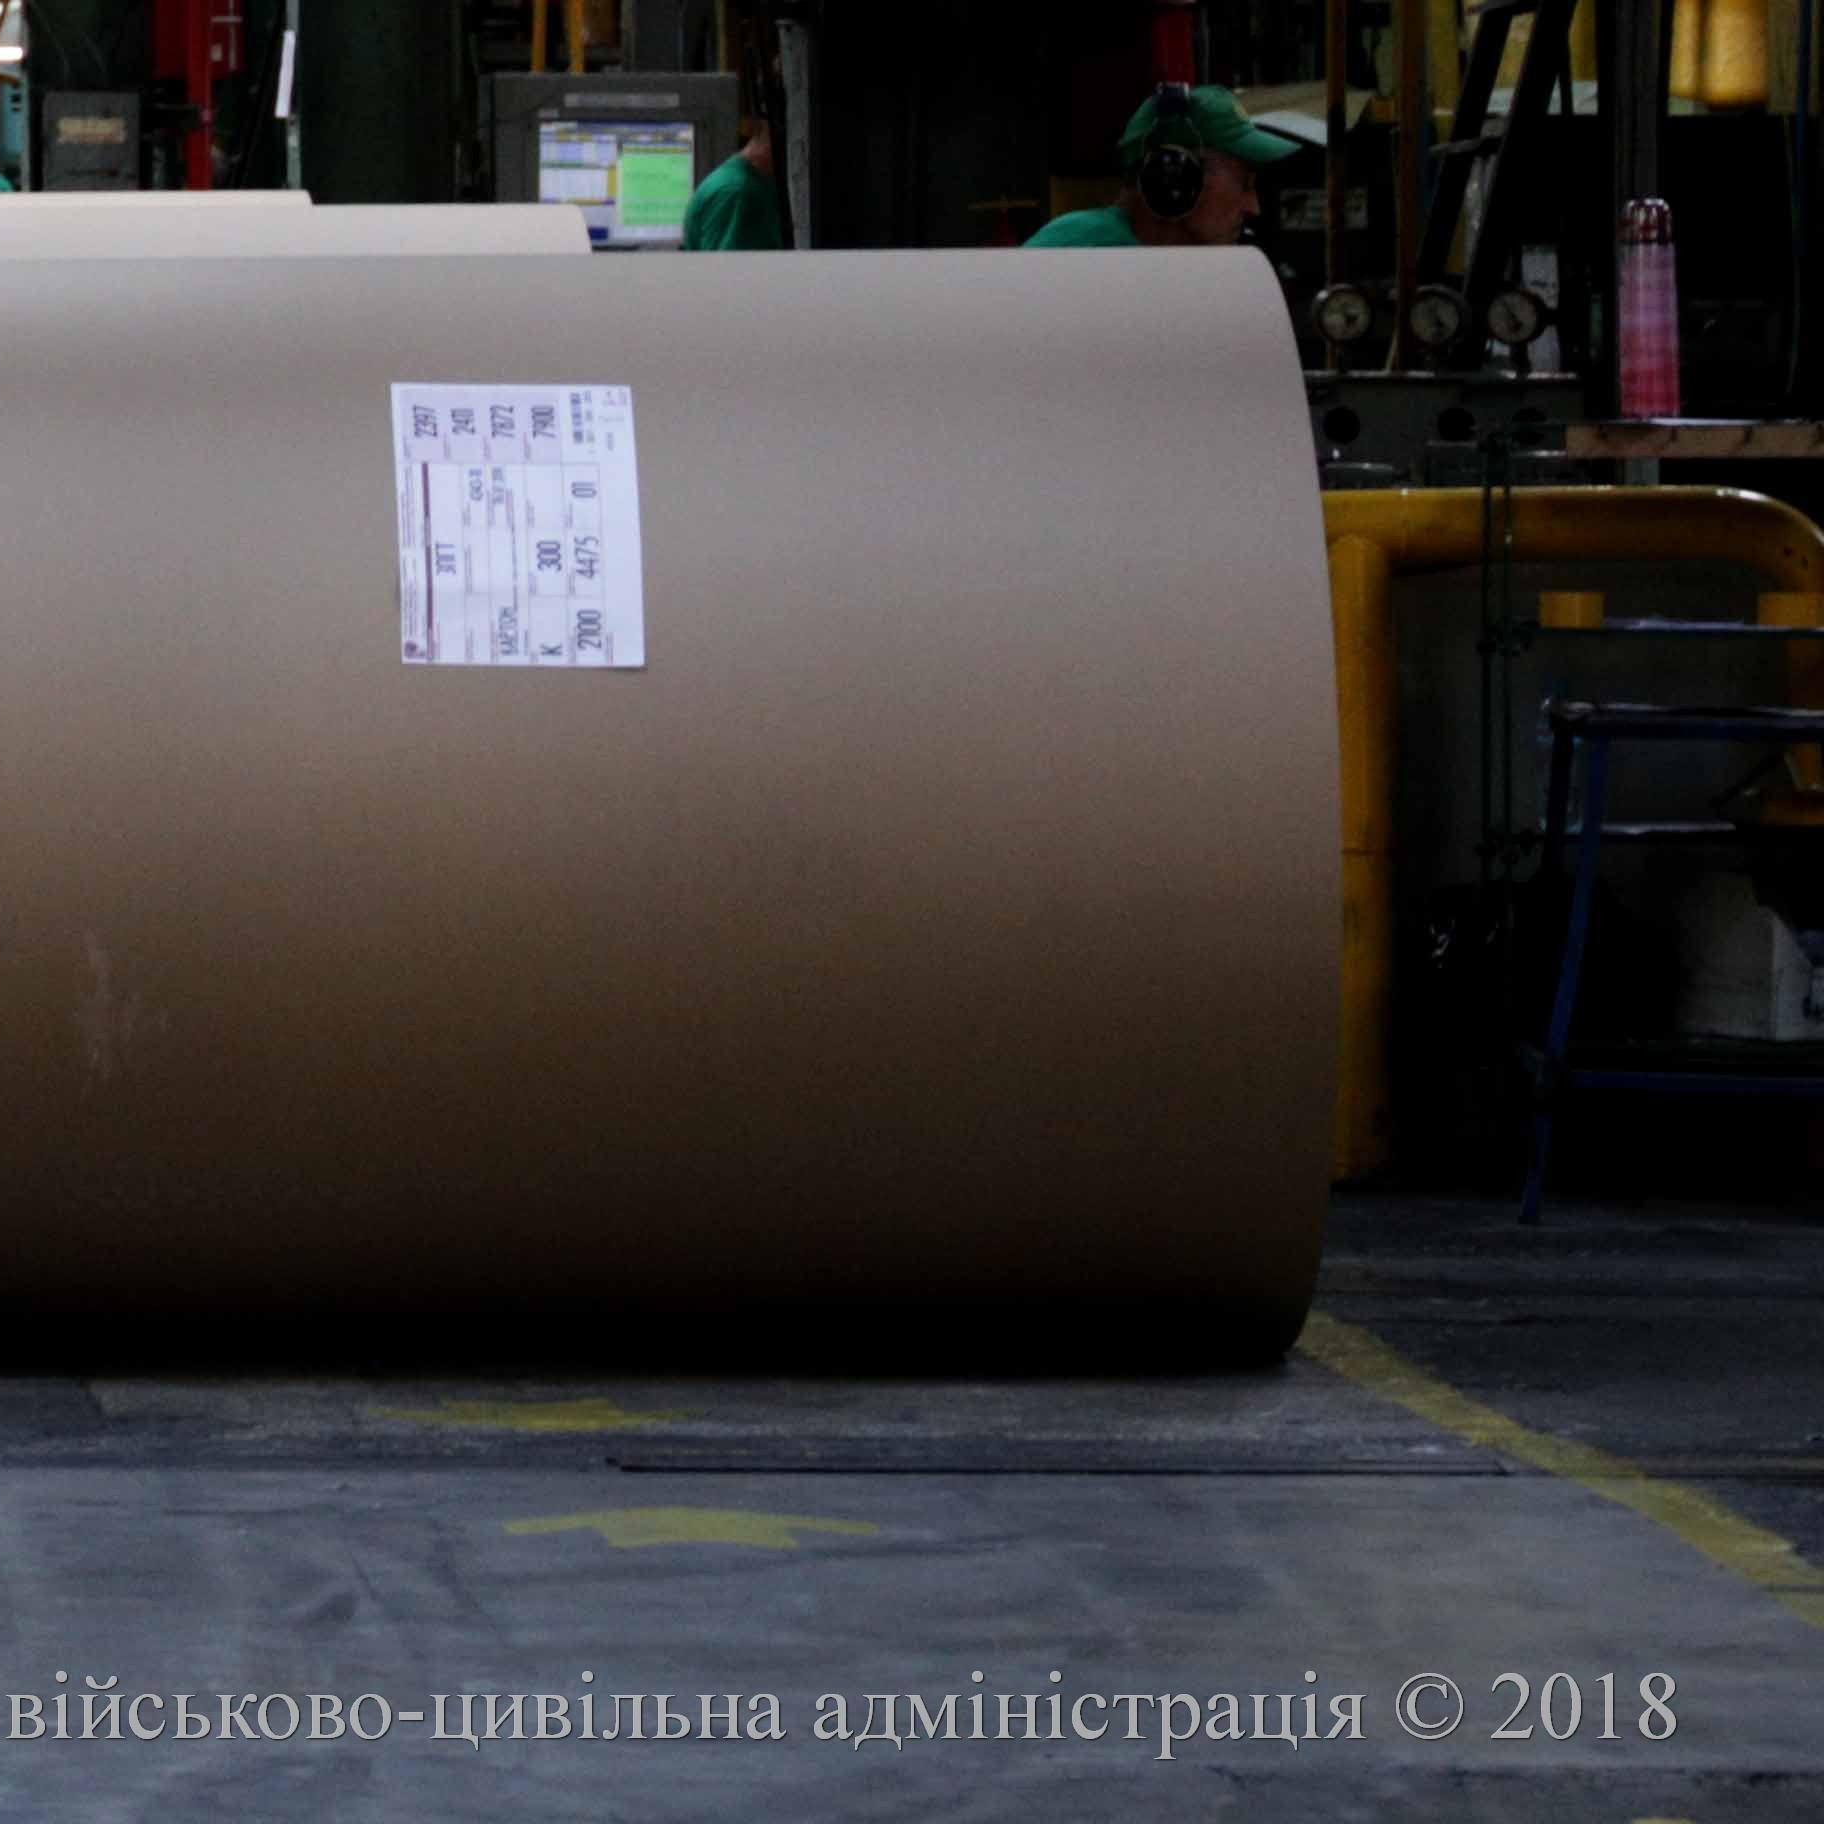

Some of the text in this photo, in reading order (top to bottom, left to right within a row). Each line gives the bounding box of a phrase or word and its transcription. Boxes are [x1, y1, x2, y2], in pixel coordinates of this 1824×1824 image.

[536, 539, 563, 572] 300
[574, 536, 600, 579] 4475
[576, 608, 602, 651] 2100
